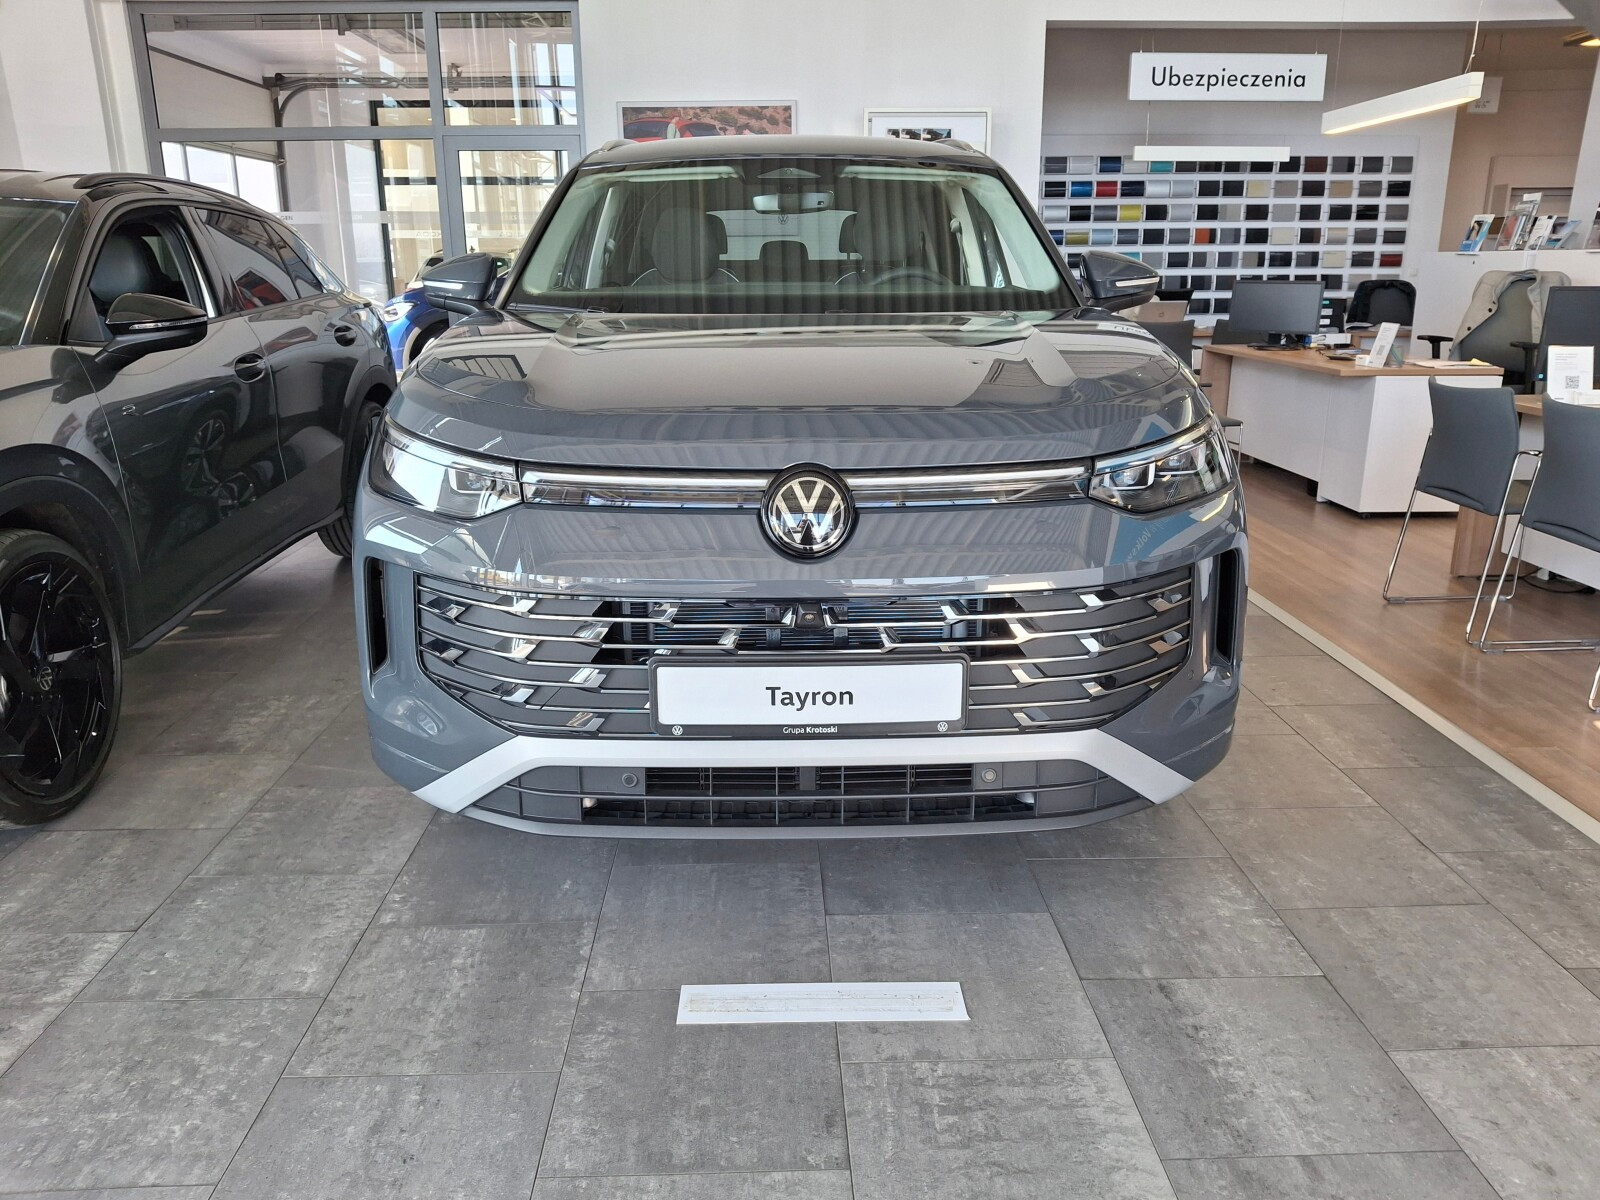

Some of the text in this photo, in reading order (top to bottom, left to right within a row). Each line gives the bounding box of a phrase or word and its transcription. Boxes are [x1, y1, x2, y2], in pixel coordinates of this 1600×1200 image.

[1151, 65, 1306, 92] Ubezpieczenia
[765, 686, 854, 712] Tayron
[782, 725, 838, 735] Grupa Krotoski
